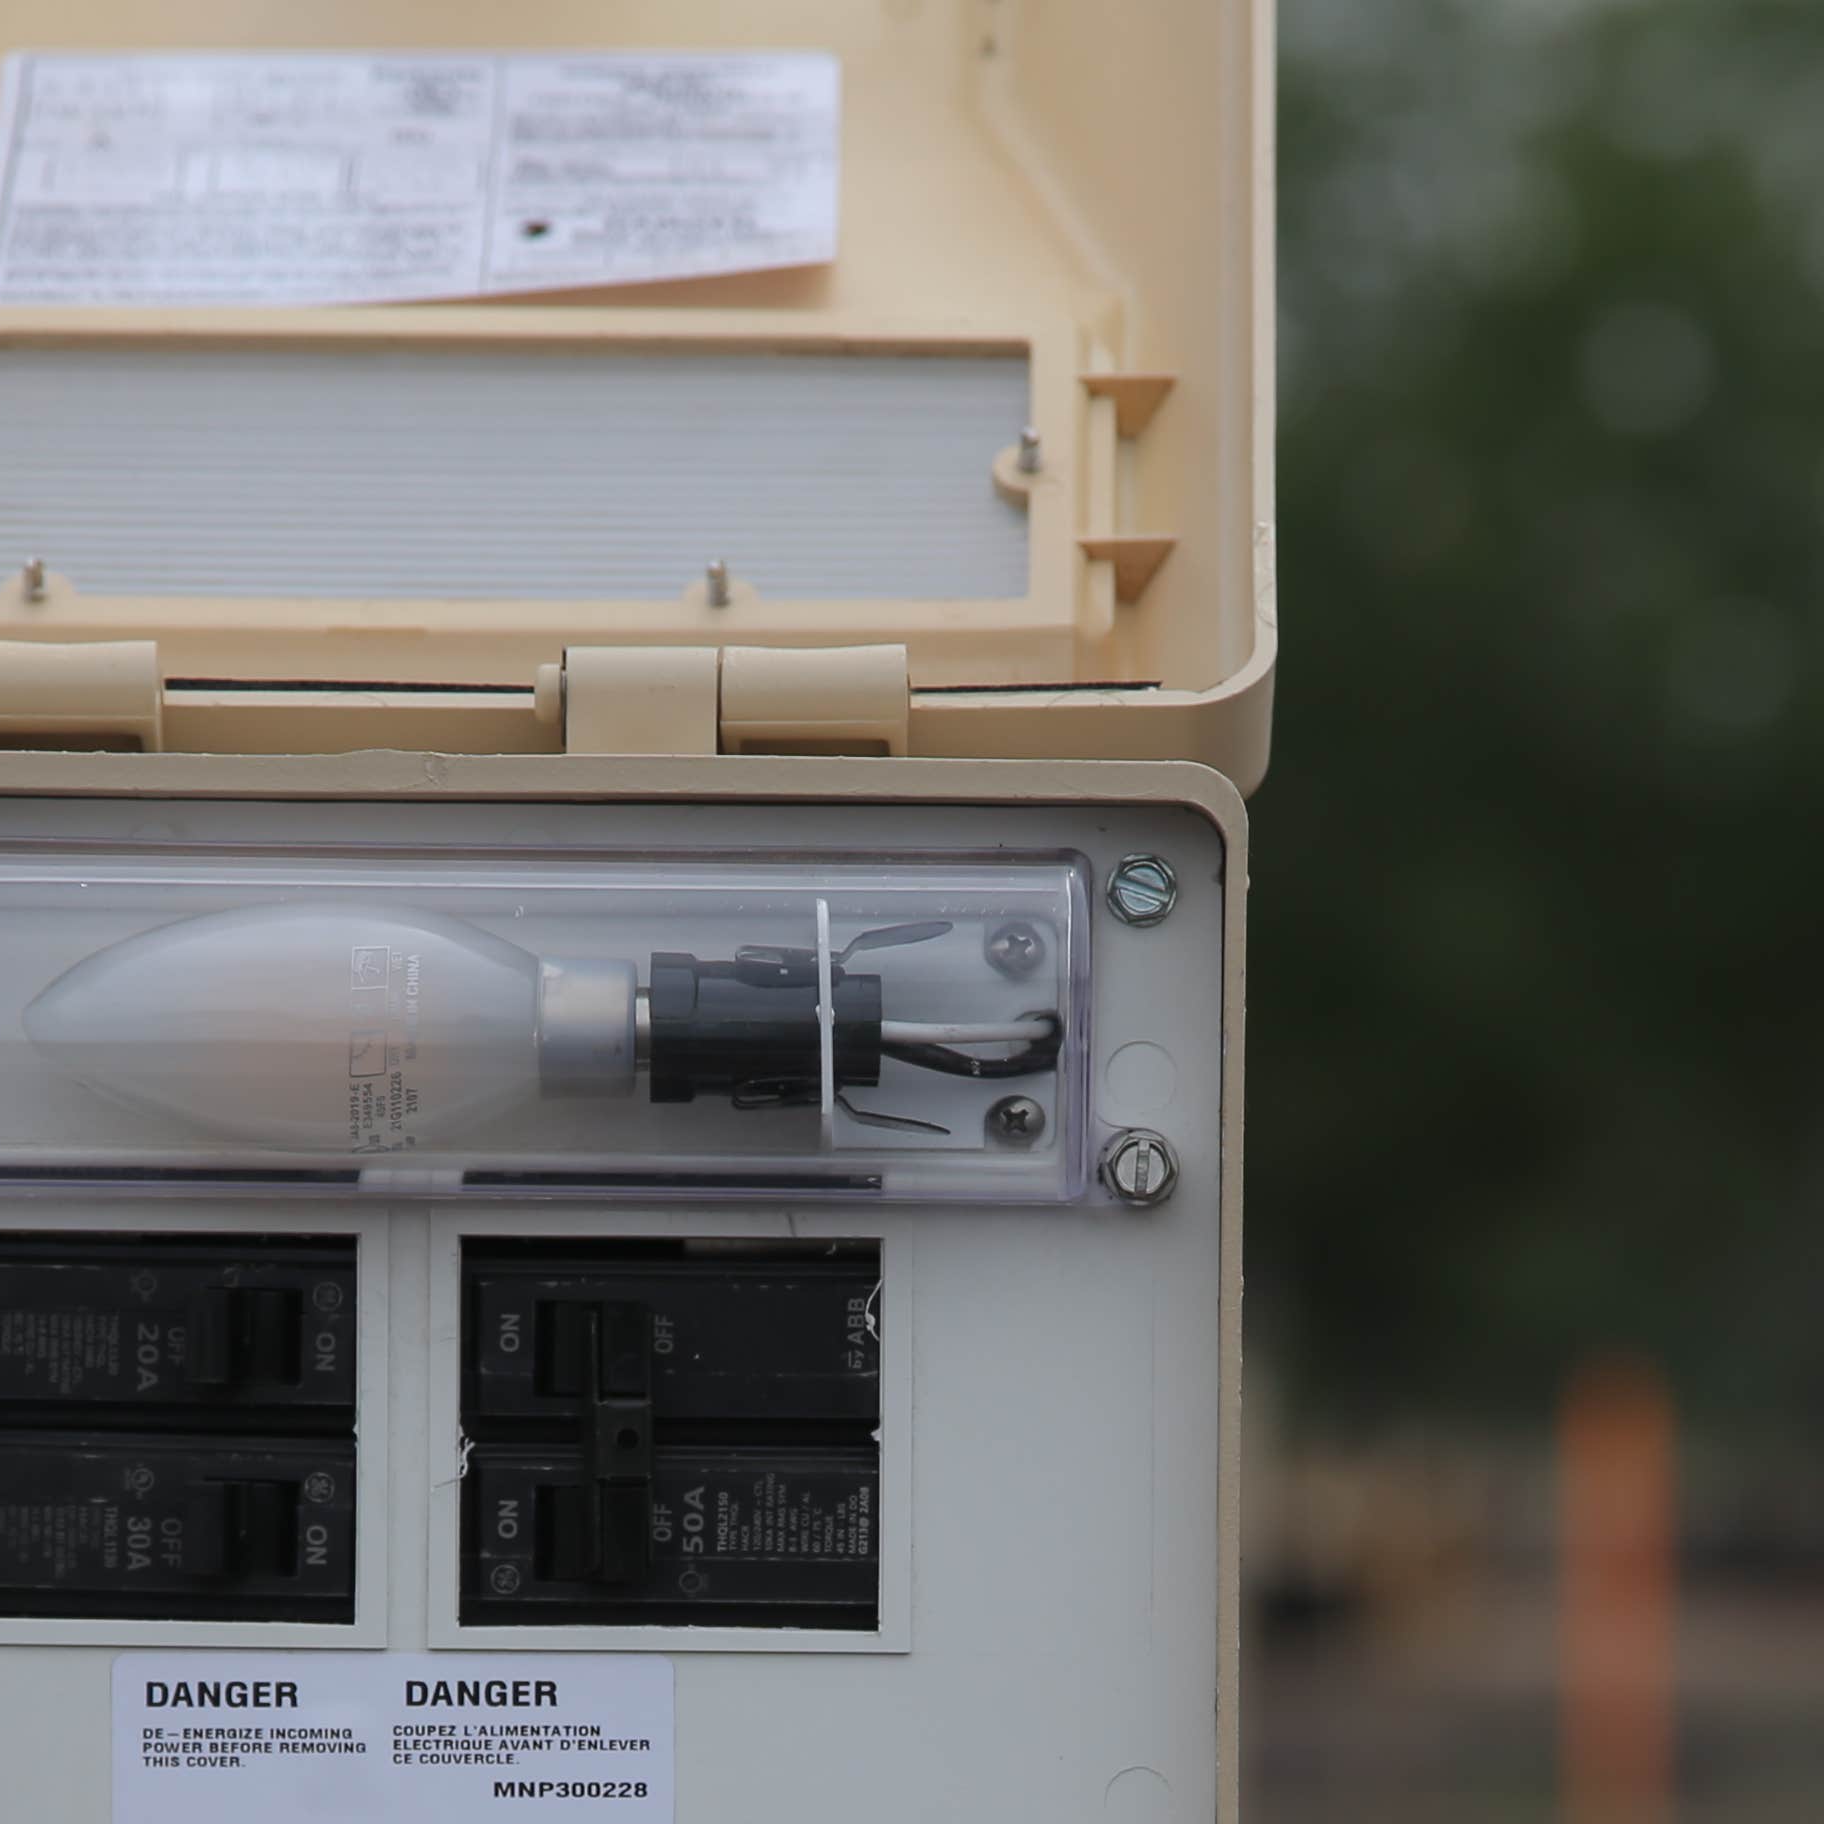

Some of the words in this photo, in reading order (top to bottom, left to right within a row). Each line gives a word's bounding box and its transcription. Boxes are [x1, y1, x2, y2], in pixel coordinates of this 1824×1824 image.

[406, 954, 420, 996] CHINA
[500, 1313, 520, 1352] ON
[654, 1314, 675, 1354] OFF
[848, 1297, 865, 1345] ABB
[136, 1322, 159, 1392] 20A
[167, 1327, 185, 1367] OFF
[315, 1332, 336, 1372] ON
[497, 1499, 519, 1539] ON
[653, 1503, 672, 1542] OFF
[683, 1485, 705, 1554] 50A
[716, 1491, 729, 1553] THQL2150
[824, 1516, 833, 1553] TORQUE
[126, 1516, 151, 1571] 30A
[161, 1517, 183, 1568] OFF
[306, 1524, 327, 1565] ON
[848, 1527, 857, 1554] MADE
[147, 1682, 297, 1707] DANGER
[406, 1681, 557, 1707] DANGER
[143, 1742, 202, 1753] POWER
[210, 1742, 272, 1753] BEFORE
[280, 1742, 366, 1753] REMOVING
[270, 1728, 352, 1739] INCOMING
[393, 1725, 456, 1736] COUPEZ
[464, 1725, 600, 1736] L'ALIMENTATION
[394, 1739, 492, 1750] ELECTRIQUE
[499, 1740, 553, 1750] AVANT
[560, 1740, 650, 1750] D'ENLEVER
[143, 1756, 180, 1767] THIS
[187, 1756, 246, 1767] COVER.
[393, 1754, 412, 1764] CE
[419, 1754, 518, 1764] COUVERCLE.
[494, 1782, 647, 1797] MNP300228
